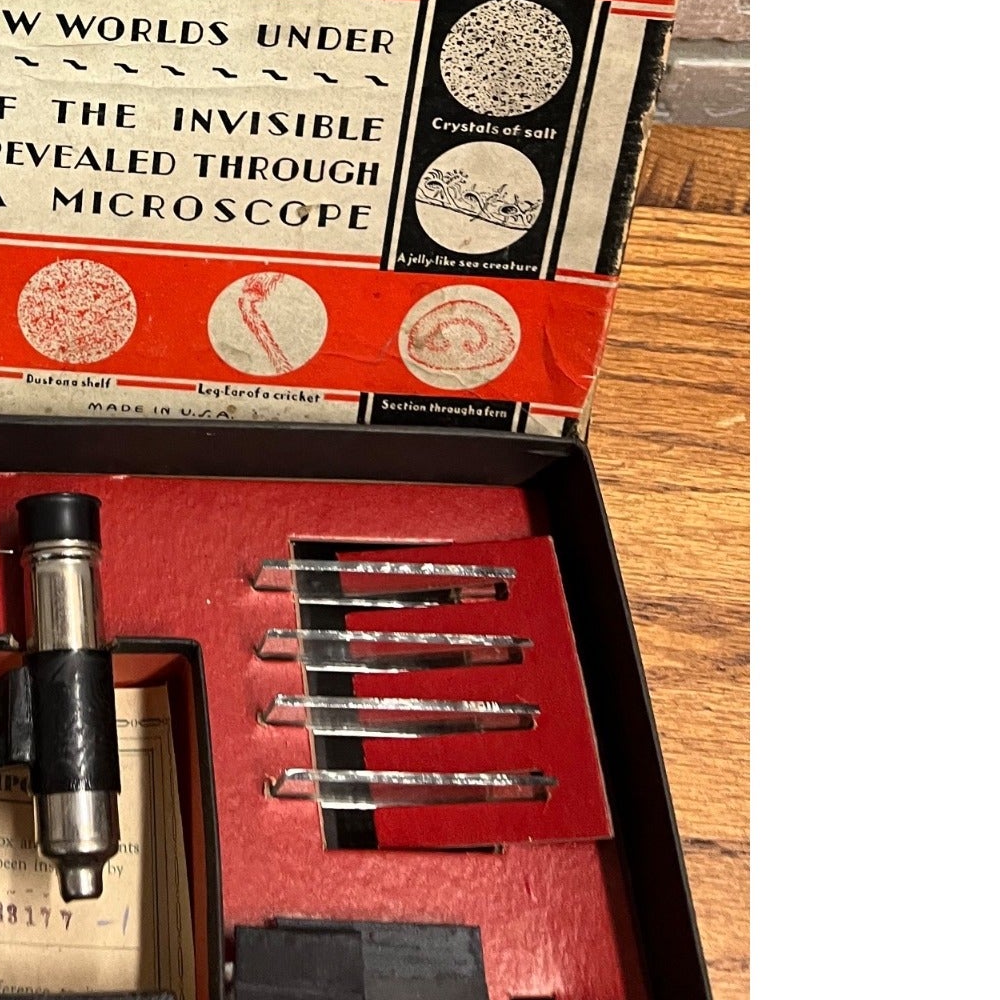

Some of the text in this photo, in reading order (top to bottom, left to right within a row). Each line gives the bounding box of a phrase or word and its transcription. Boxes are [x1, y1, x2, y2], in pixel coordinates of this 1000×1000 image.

[56, 13, 230, 46] WORLDS
[256, 23, 394, 54] UNDER
[51, 99, 137, 129] THE
[173, 106, 385, 142] INVISIBLE
[431, 117, 558, 140] Crystals of salt
[193, 153, 380, 187] THROUGH
[52, 186, 373, 231] MICROSCOPE
[396, 251, 539, 273] A jelly-like sea creature
[81, 376, 112, 389] shelf
[273, 390, 321, 404] cricket
[87, 402, 234, 420] MADE IN U.S.A.
[381, 399, 427, 412] Section
[484, 406, 508, 419] fern
[20, 838, 38, 850] an
[107, 860, 124, 878] by
